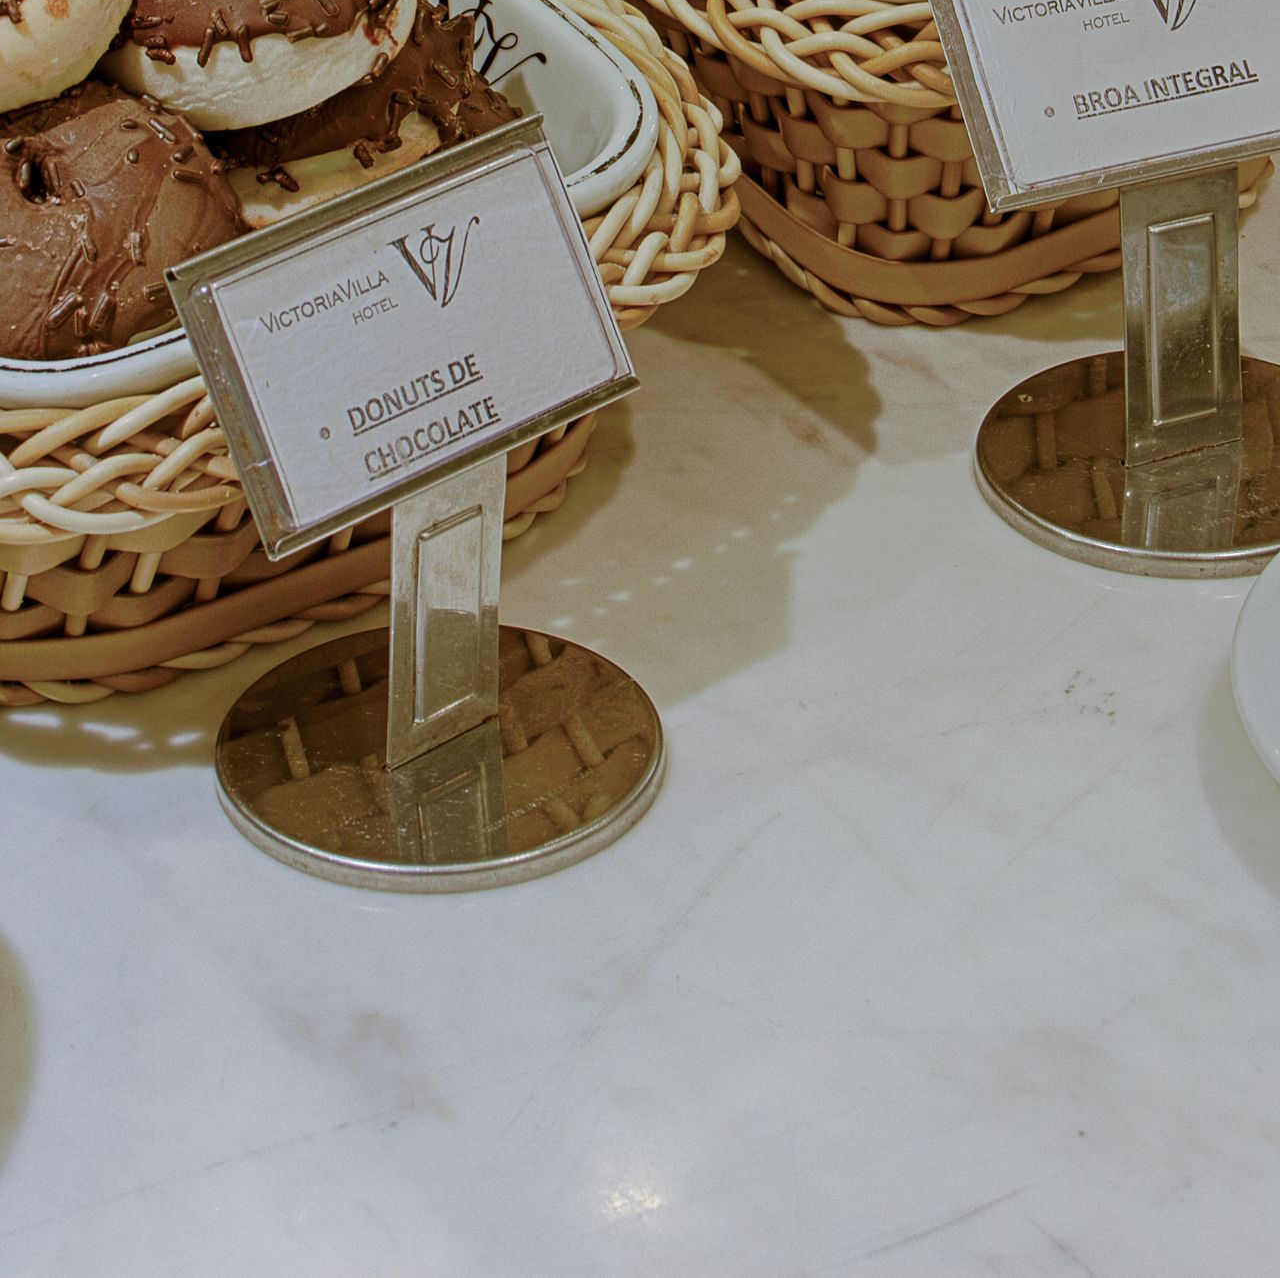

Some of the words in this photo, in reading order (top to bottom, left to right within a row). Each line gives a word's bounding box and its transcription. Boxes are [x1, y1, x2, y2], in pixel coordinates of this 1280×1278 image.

[1083, 12, 1130, 31] HOTEL
[1073, 87, 1141, 115] BROA
[1144, 59, 1258, 99] INTEGRAL
[353, 298, 399, 324] HOTEL
[347, 370, 445, 432] DONUTS
[448, 354, 482, 386] DE
[364, 397, 500, 478] CHOCOLATE
